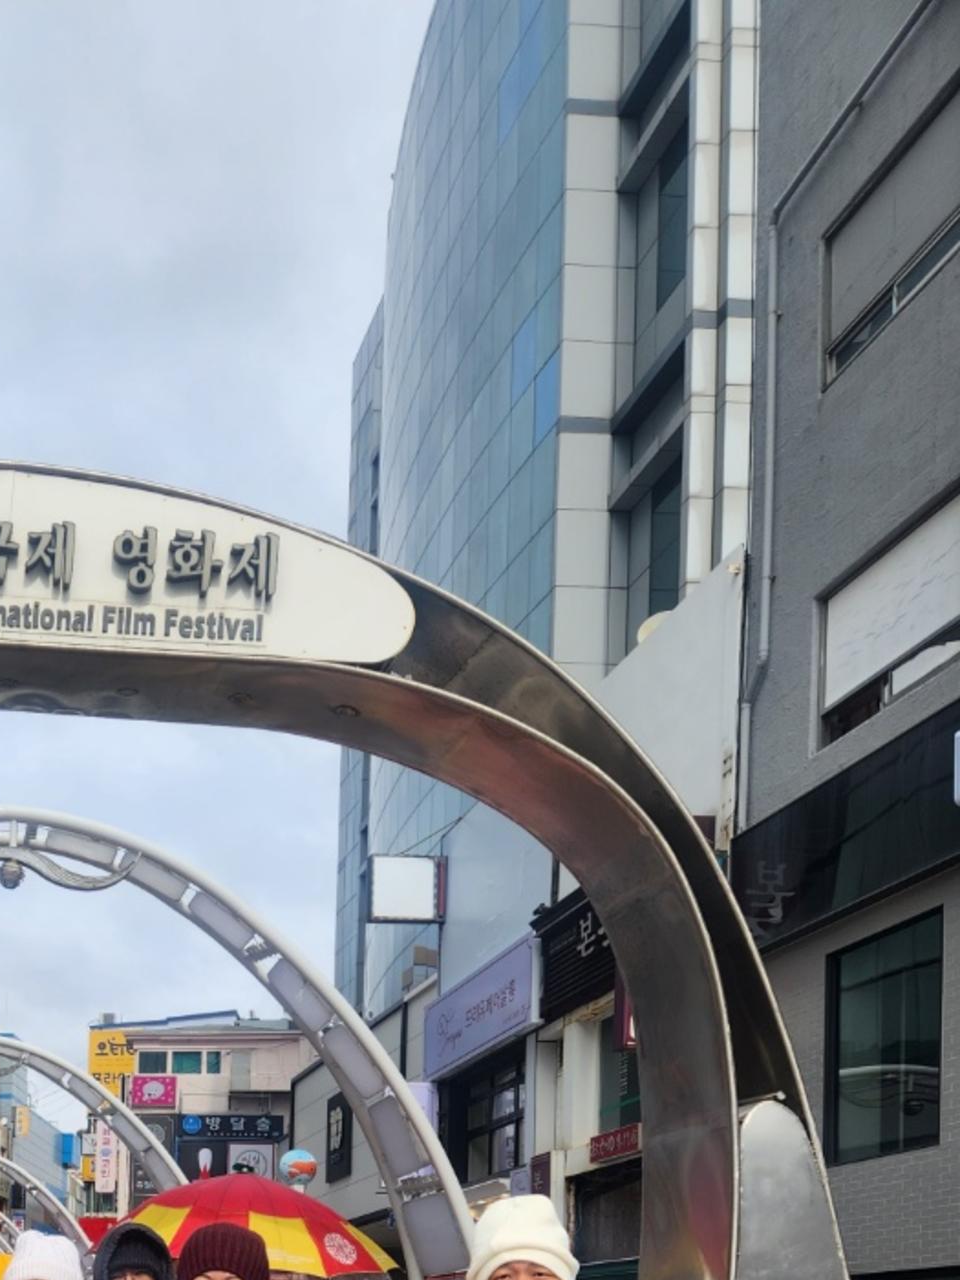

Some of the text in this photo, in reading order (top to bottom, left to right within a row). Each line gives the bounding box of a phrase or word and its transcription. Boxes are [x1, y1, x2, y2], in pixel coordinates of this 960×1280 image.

[113, 526, 280, 602] 영화제
[102, 605, 156, 637] Film
[164, 608, 265, 642] Festival
